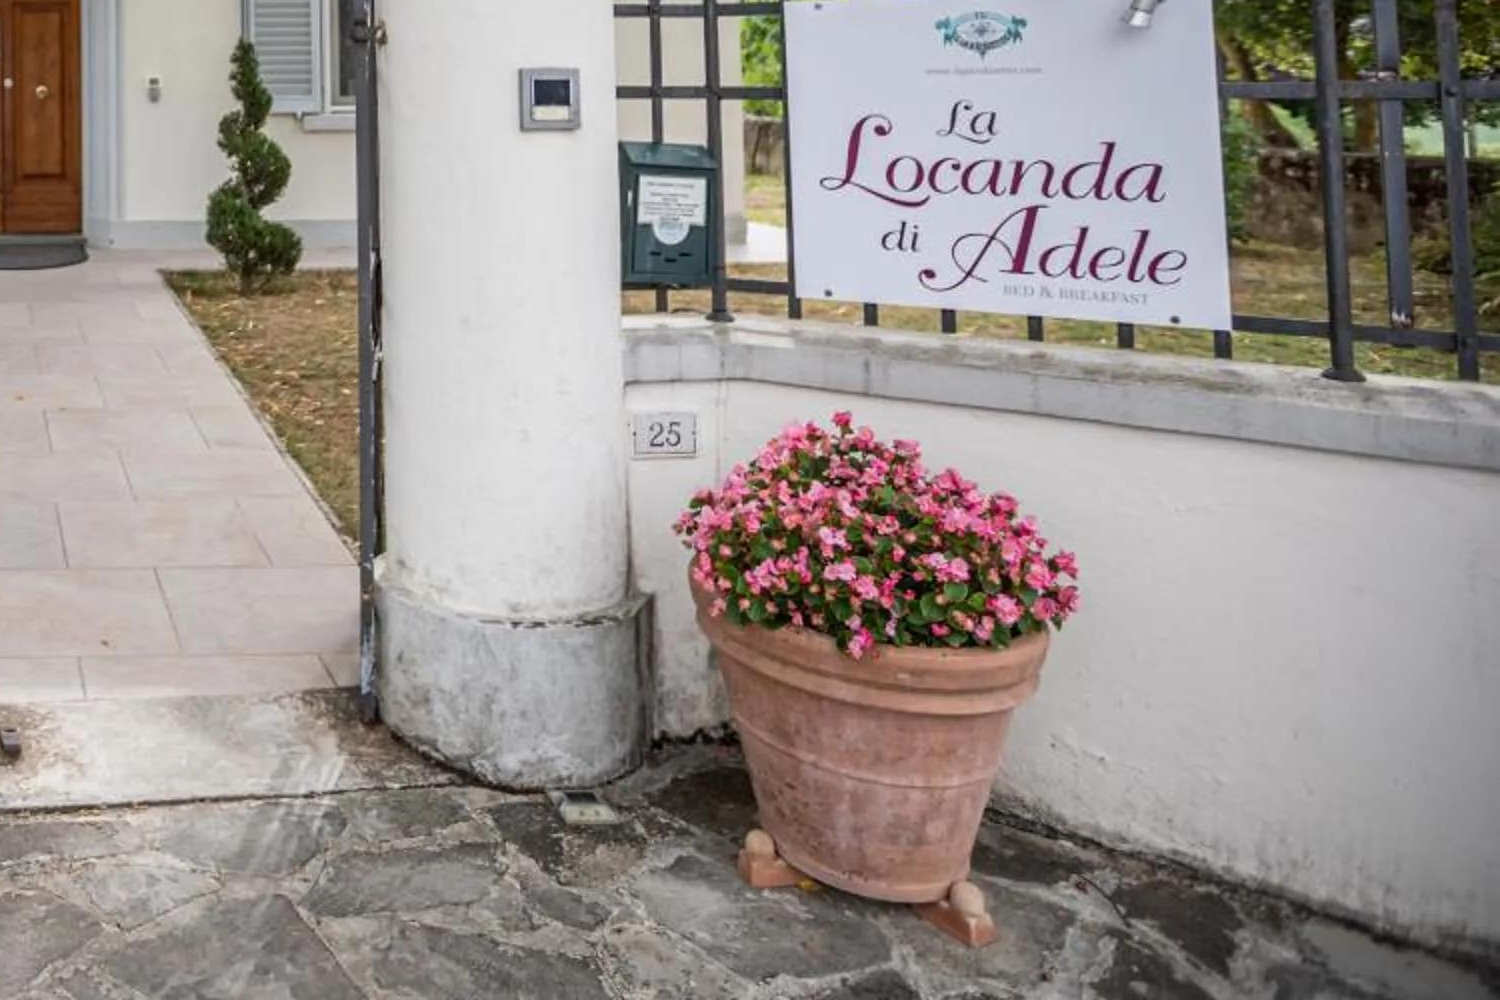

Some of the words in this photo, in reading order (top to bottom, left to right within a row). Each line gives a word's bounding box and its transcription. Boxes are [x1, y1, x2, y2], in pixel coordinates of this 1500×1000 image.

[936, 99, 998, 144] La
[819, 113, 1167, 208] Locanda
[880, 220, 921, 253] di
[918, 204, 1188, 292] Adele
[1002, 283, 1035, 297] BED
[1040, 285, 1053, 299] &
[1059, 287, 1149, 305] BREAKFAST
[649, 421, 682, 447] 25
